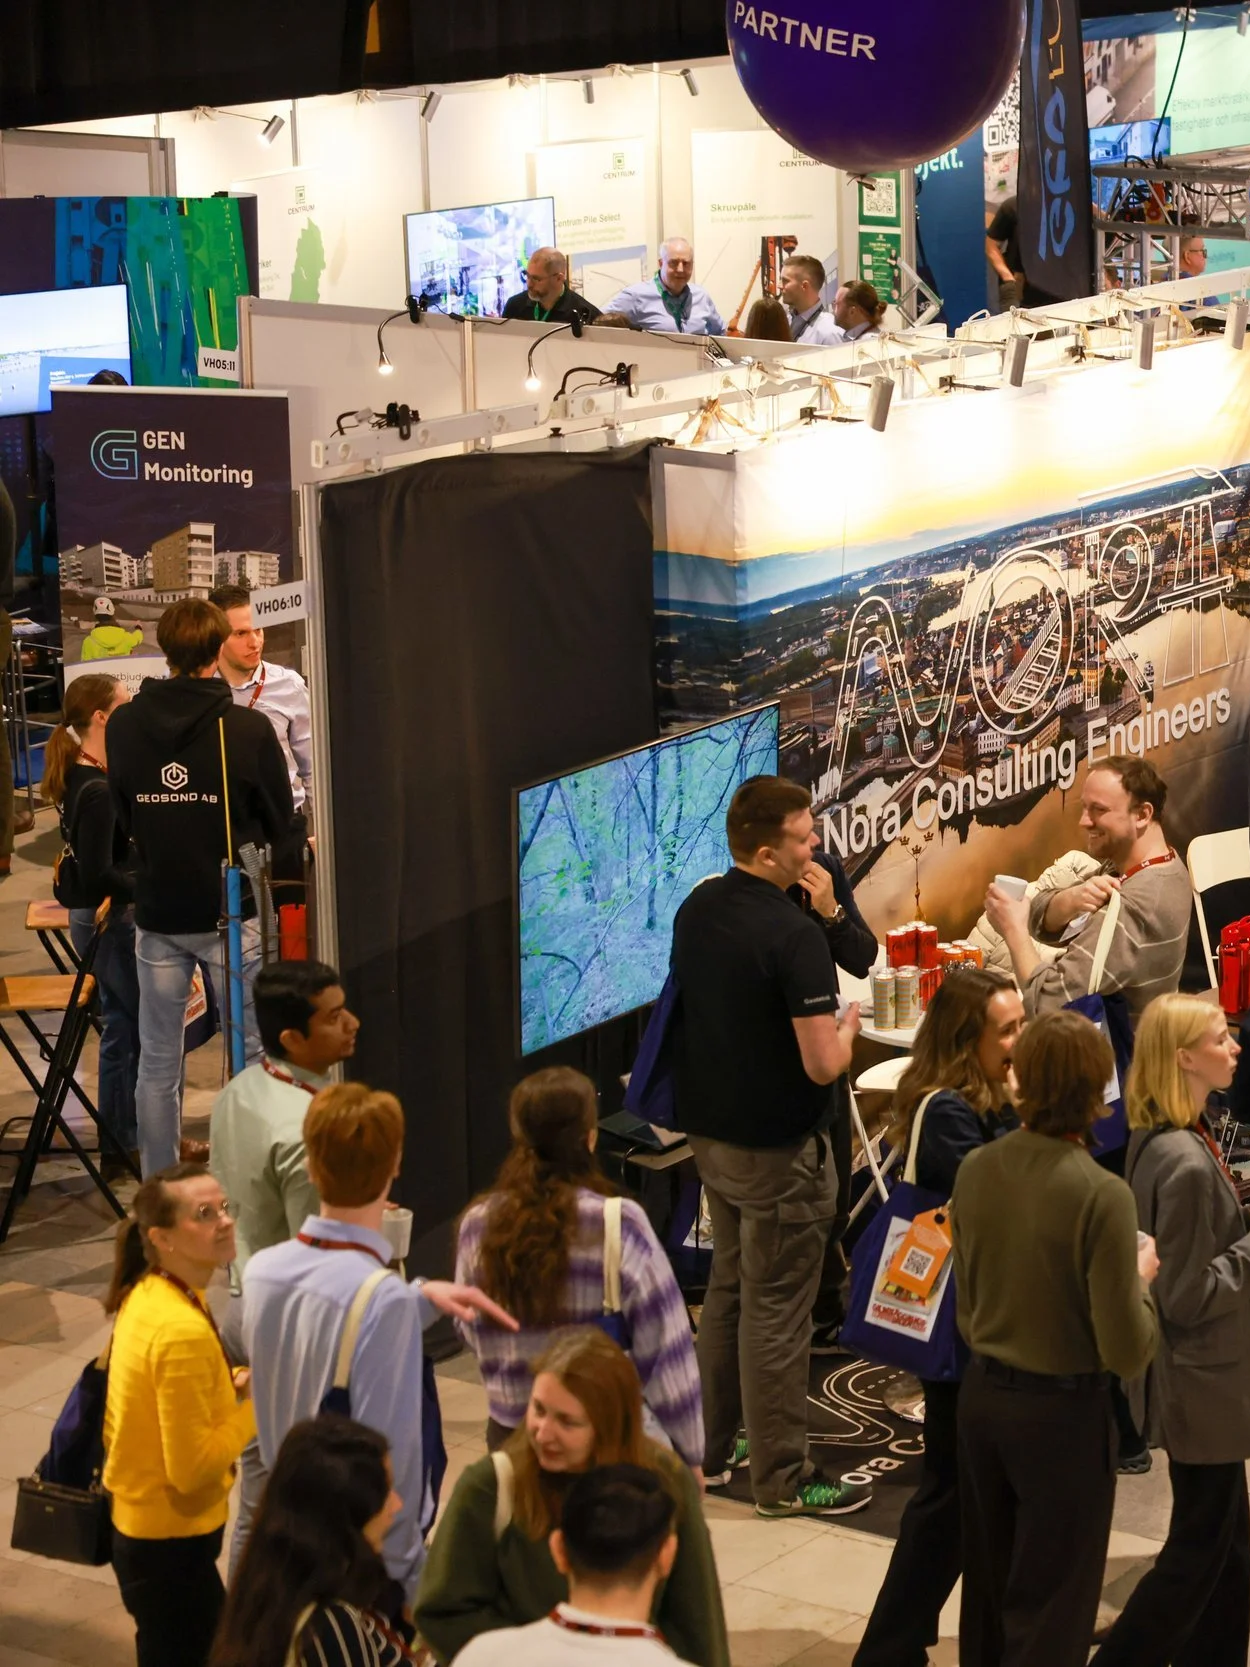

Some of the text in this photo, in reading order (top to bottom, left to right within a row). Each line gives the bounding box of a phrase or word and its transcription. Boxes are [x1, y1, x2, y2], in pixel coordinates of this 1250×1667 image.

[734, 0, 876, 61] PARTNER
[779, 160, 821, 168] CENTRUM
[914, 148, 964, 181] ojekt.
[203, 357, 235, 371] VH05:11
[142, 430, 185, 450] GEN
[144, 462, 253, 489] Monitoring
[255, 593, 302, 616] VH06:10
[823, 687, 1231, 859] Nora Consulting Engineers
[136, 791, 218, 804] GEOSOND AB
[840, 1457, 906, 1485] ora
